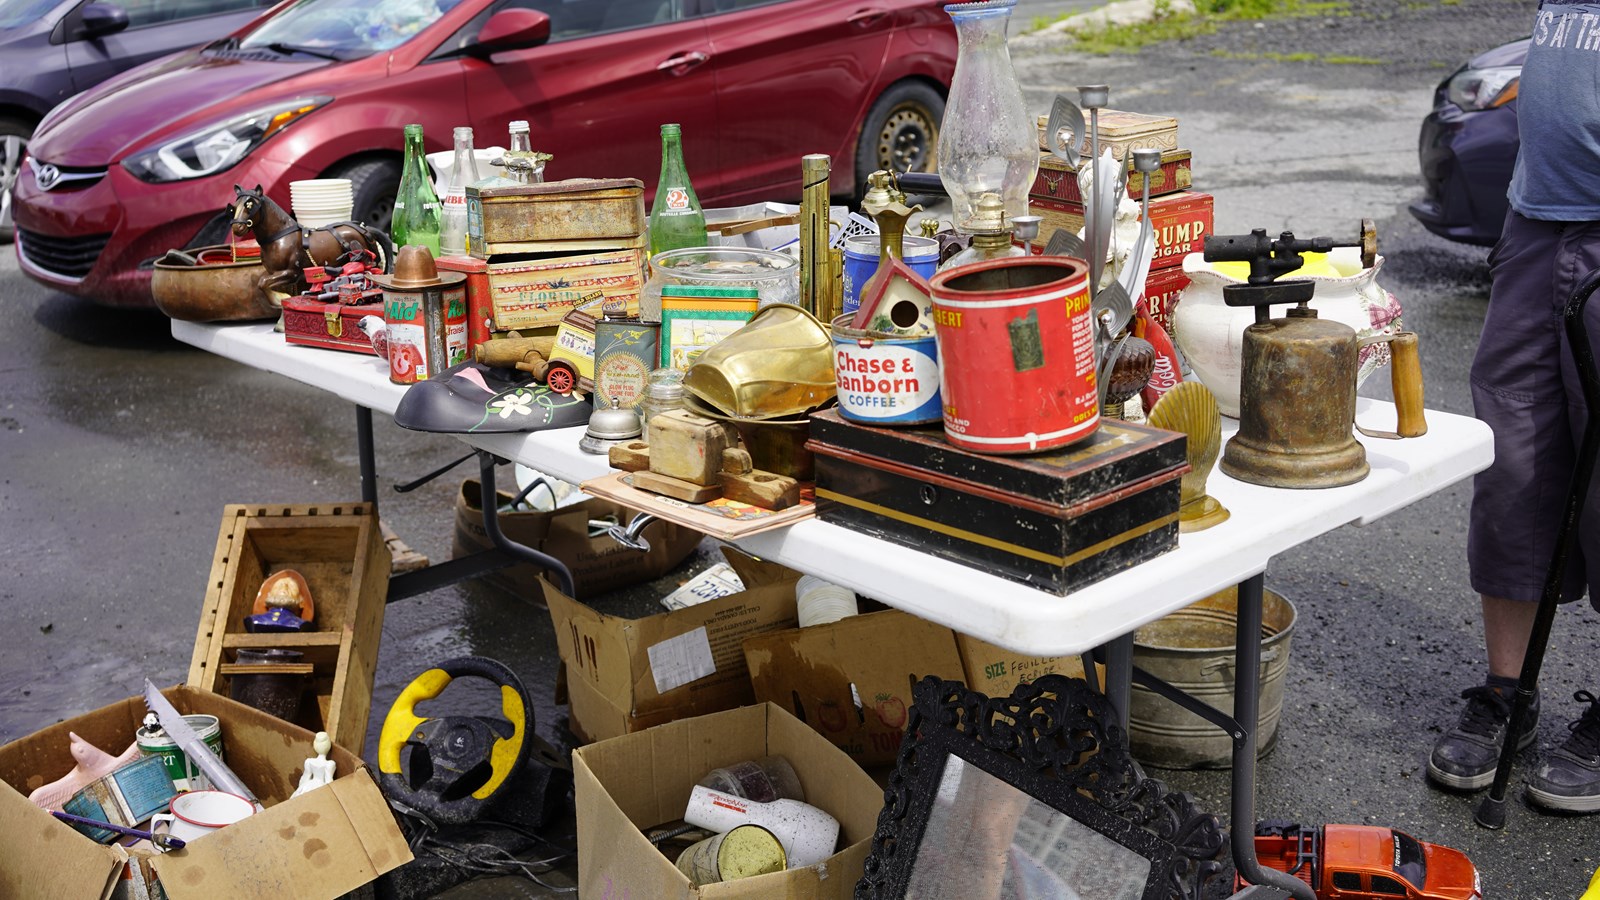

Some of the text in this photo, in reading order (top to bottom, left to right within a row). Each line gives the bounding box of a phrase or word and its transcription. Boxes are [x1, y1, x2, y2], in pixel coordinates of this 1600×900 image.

[1549, 13, 1578, 48] AT
[671, 191, 682, 204] 2
[1152, 243, 1191, 259] CIGAR
[519, 291, 582, 303] FLORIDA
[450, 346, 457, 357] 7
[838, 351, 914, 373] Chase &
[836, 368, 919, 394] Sanborn
[849, 394, 897, 407] COFFEE
[953, 417, 970, 427] AND
[985, 662, 1007, 680] SIZE
